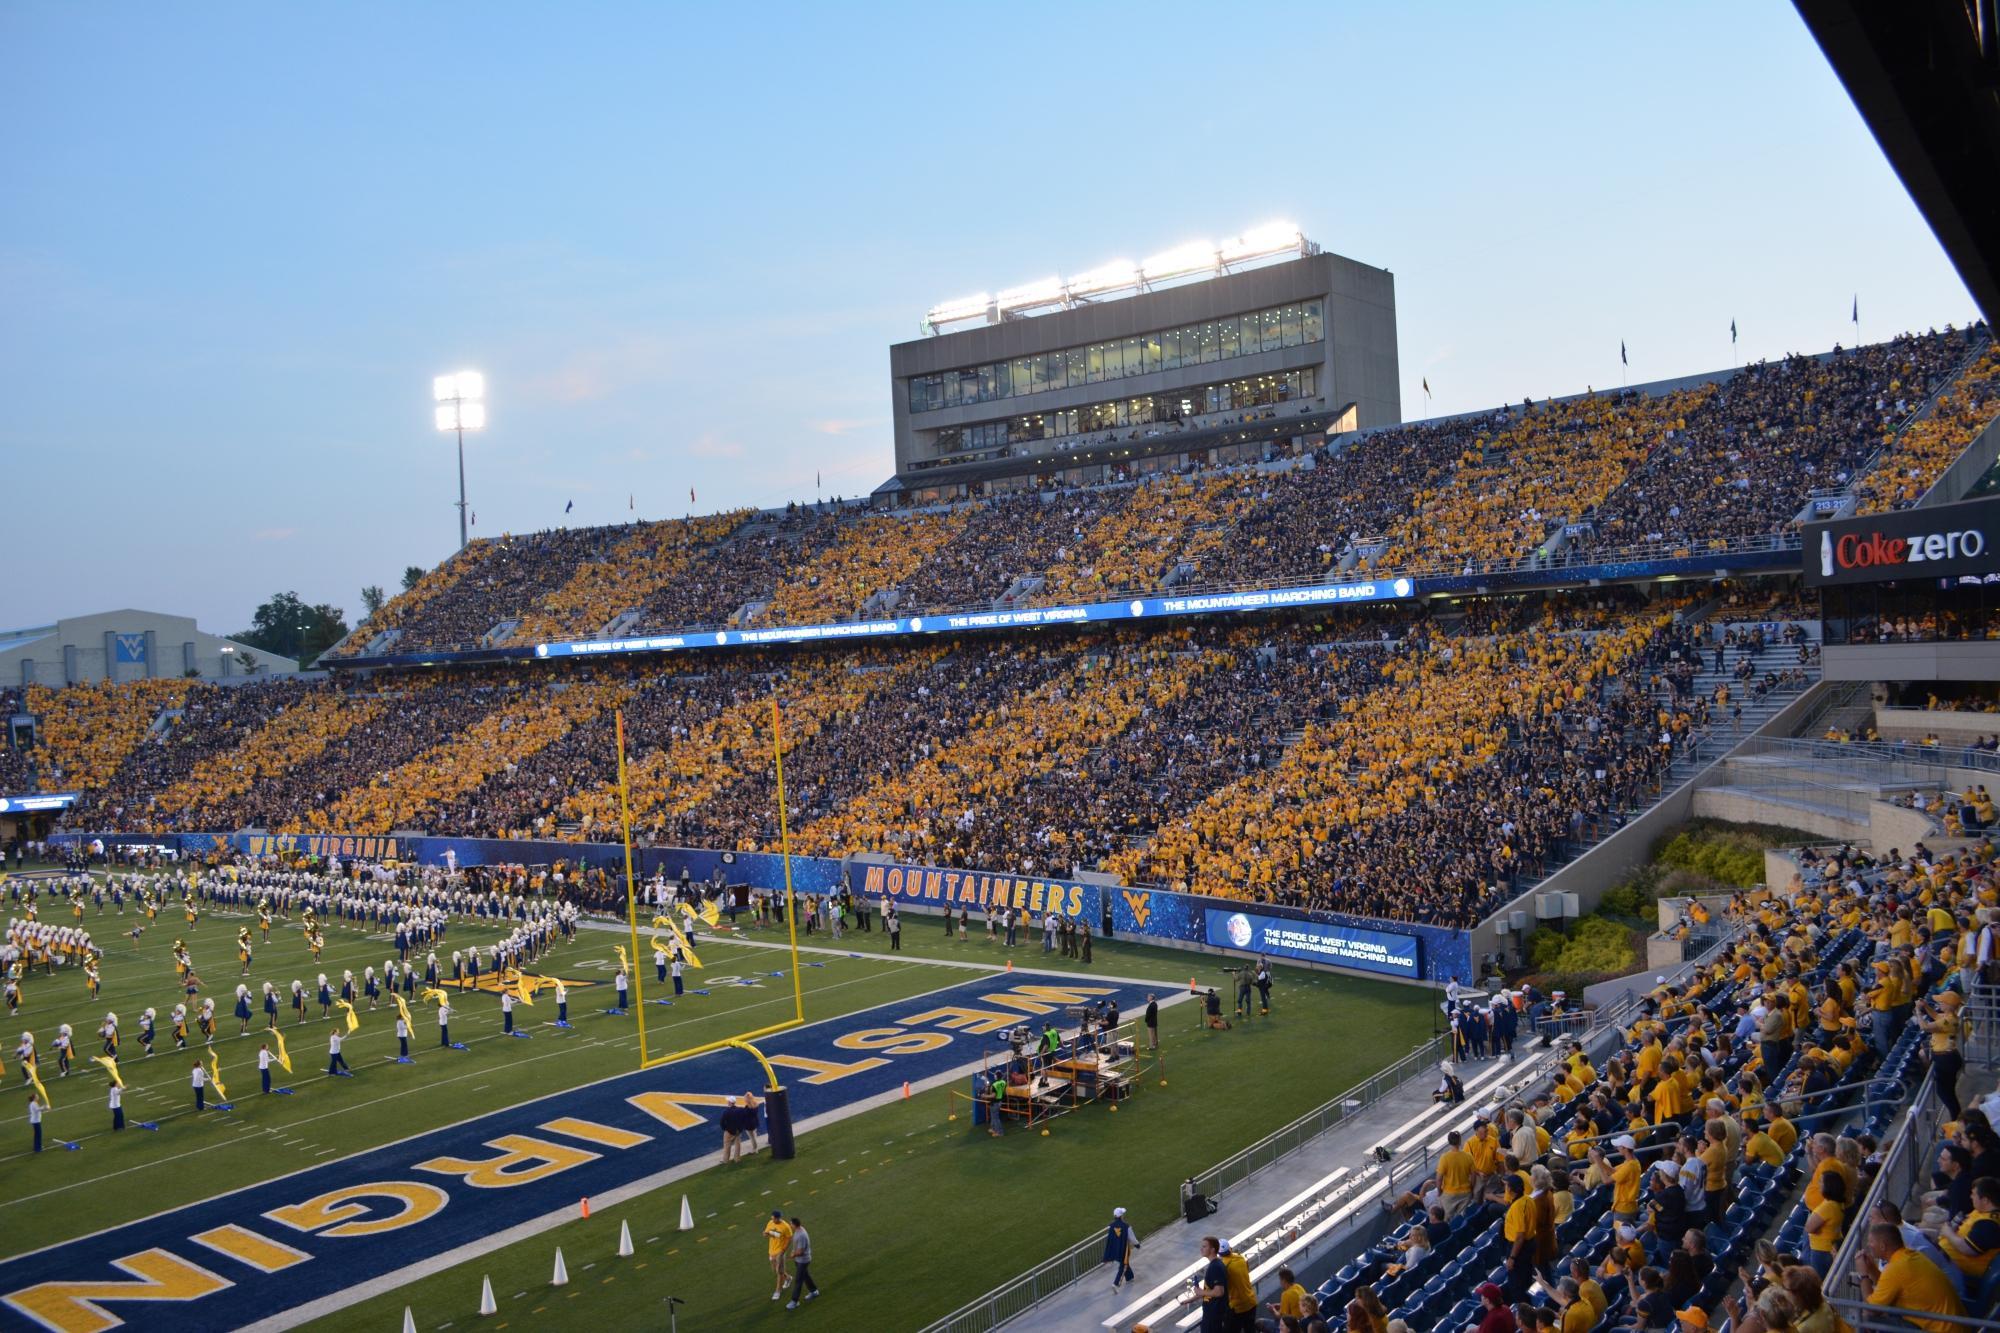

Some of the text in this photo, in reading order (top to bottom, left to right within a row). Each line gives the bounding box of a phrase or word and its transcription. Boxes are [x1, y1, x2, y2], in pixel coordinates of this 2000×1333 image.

[1837, 530, 1984, 568] Coke zero
[1163, 585, 1375, 611] THE MOUNTAINEER MARCHING BAND
[949, 608, 1087, 627] THE PRIDE OF WEST VIRGINIA
[571, 638, 684, 652] THE PRIDE OF WEST VIRGINIA
[740, 623, 897, 641] THE MOUNTAINEER MARCHING BAND
[250, 836, 398, 858] WEST VIRGINIA
[864, 866, 1084, 916] MOUNTAINEERS
[1264, 928, 1388, 954] THE PRIDE OF WEST VIRGINIA
[1264, 937, 1413, 967] THE MOUNTAINEER MARCHING BAND
[765, 985, 1122, 1085] WEST
